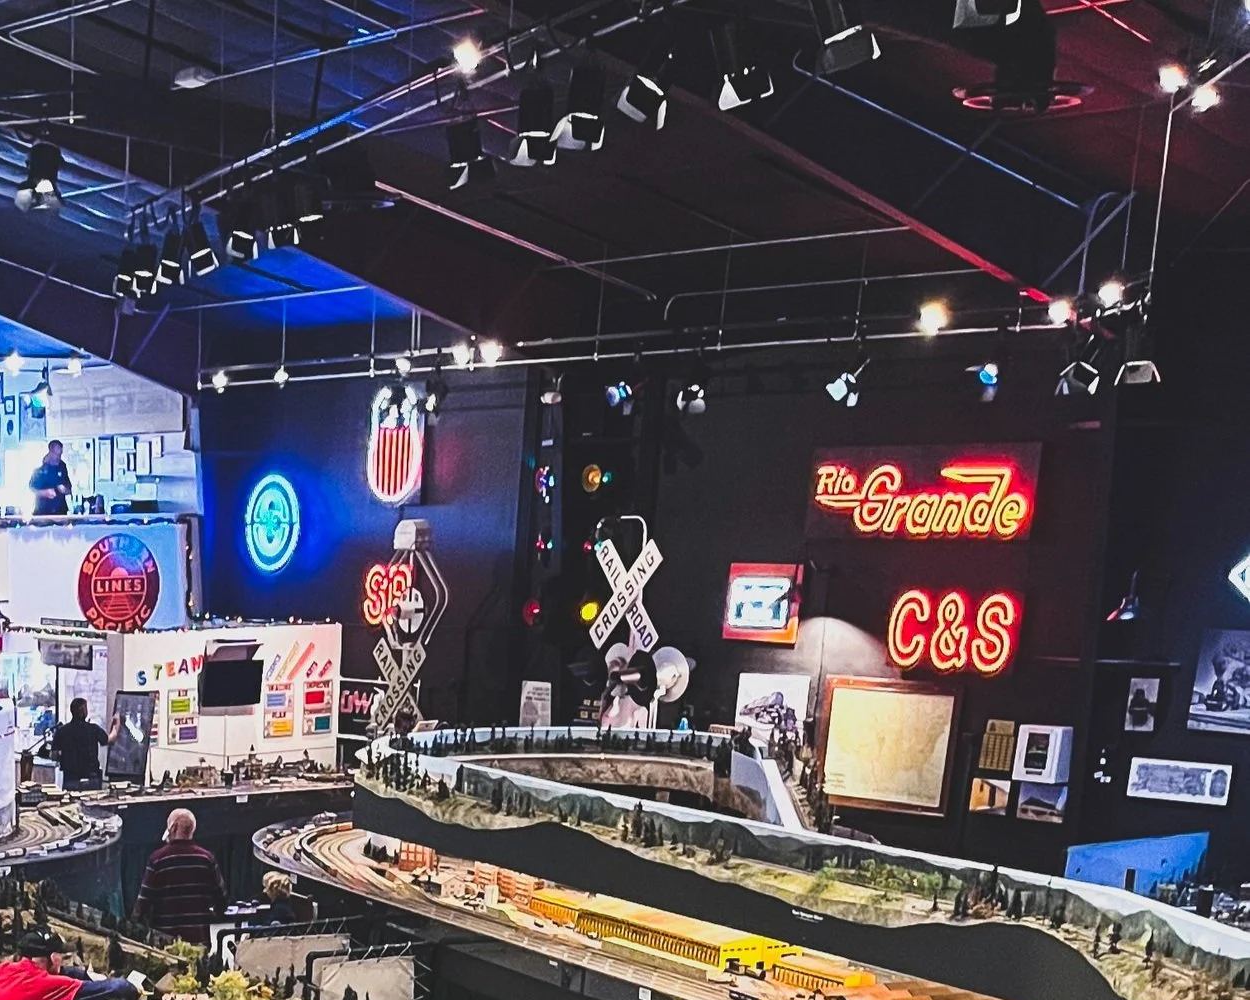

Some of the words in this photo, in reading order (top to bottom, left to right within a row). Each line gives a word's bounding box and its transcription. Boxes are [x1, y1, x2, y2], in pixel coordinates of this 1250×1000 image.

[816, 465, 856, 494] Rio
[844, 464, 1027, 535] Grande
[96, 578, 142, 593] LINES
[600, 545, 622, 588] RAIL
[594, 551, 655, 641] CROSSING
[627, 602, 654, 649] ROAD
[137, 654, 206, 686] STEAM
[374, 643, 393, 681] RAIL
[374, 648, 422, 727] CROSSING
